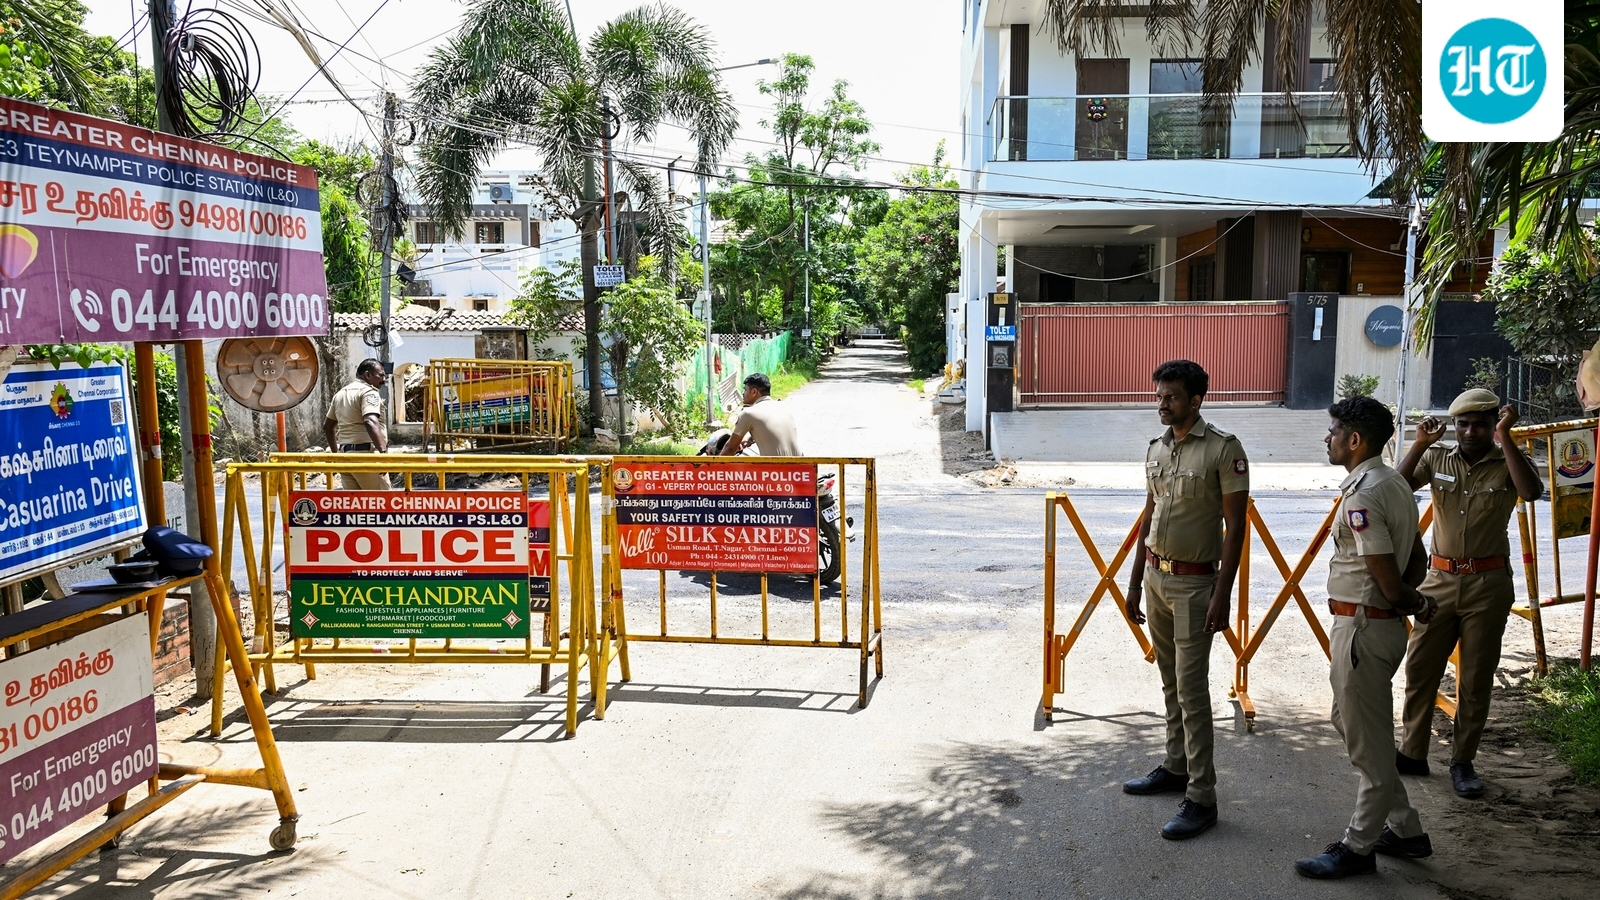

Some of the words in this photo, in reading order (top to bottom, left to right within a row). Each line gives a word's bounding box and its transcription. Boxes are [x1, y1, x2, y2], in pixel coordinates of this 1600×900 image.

[24, 142, 142, 177] TEYNAMPET
[148, 164, 205, 188] POLICE
[208, 176, 264, 198] STATION
[267, 186, 299, 206] (L&O)
[131, 136, 228, 170] CHENNAI
[234, 159, 298, 184] POLICE
[45, 180, 174, 230] உதவிக்கு
[180, 200, 246, 233] 94981
[250, 212, 308, 240] 00186
[135, 243, 171, 275] For
[178, 247, 279, 288] Emergency
[111, 288, 179, 333] 044
[186, 290, 259, 330] 4000
[264, 293, 324, 329] 6000
[1307, 295, 1328, 305] 5/75
[78, 389, 96, 398] Chennai
[96, 388, 120, 396] Corporation
[634, 471, 694, 481] GREATER
[699, 471, 757, 481] CHENNAI
[762, 471, 810, 482] POLICE
[766, 484, 774, 493] (L
[784, 484, 794, 493] O)
[0, 484, 87, 531] Casuarina
[90, 474, 132, 506] Drive
[320, 497, 386, 510] GREATER
[390, 497, 461, 510] CHENNAI
[466, 497, 521, 510] POLICE
[323, 514, 341, 526] J8
[346, 514, 454, 526] NEELANKARAI
[467, 514, 523, 526] PS.L&O
[630, 513, 659, 523] YOUR
[662, 513, 701, 523] SAFETY
[705, 513, 714, 523] IS
[718, 513, 740, 523] OUR
[743, 514, 793, 524] PRIORITY
[306, 529, 515, 563] POLICE
[666, 526, 718, 543] SILK
[724, 527, 811, 545] SAREES
[645, 552, 668, 564] 100
[301, 582, 519, 606] JEYACHANDRAN
[530, 598, 550, 608] 77
[5, 648, 114, 708] உதவிக்கு
[23, 689, 99, 741] 00186
[10, 767, 41, 798] For
[44, 725, 133, 781] Emergency
[11, 803, 54, 840] 044
[58, 768, 108, 813] 4000
[111, 744, 154, 786] 6000
